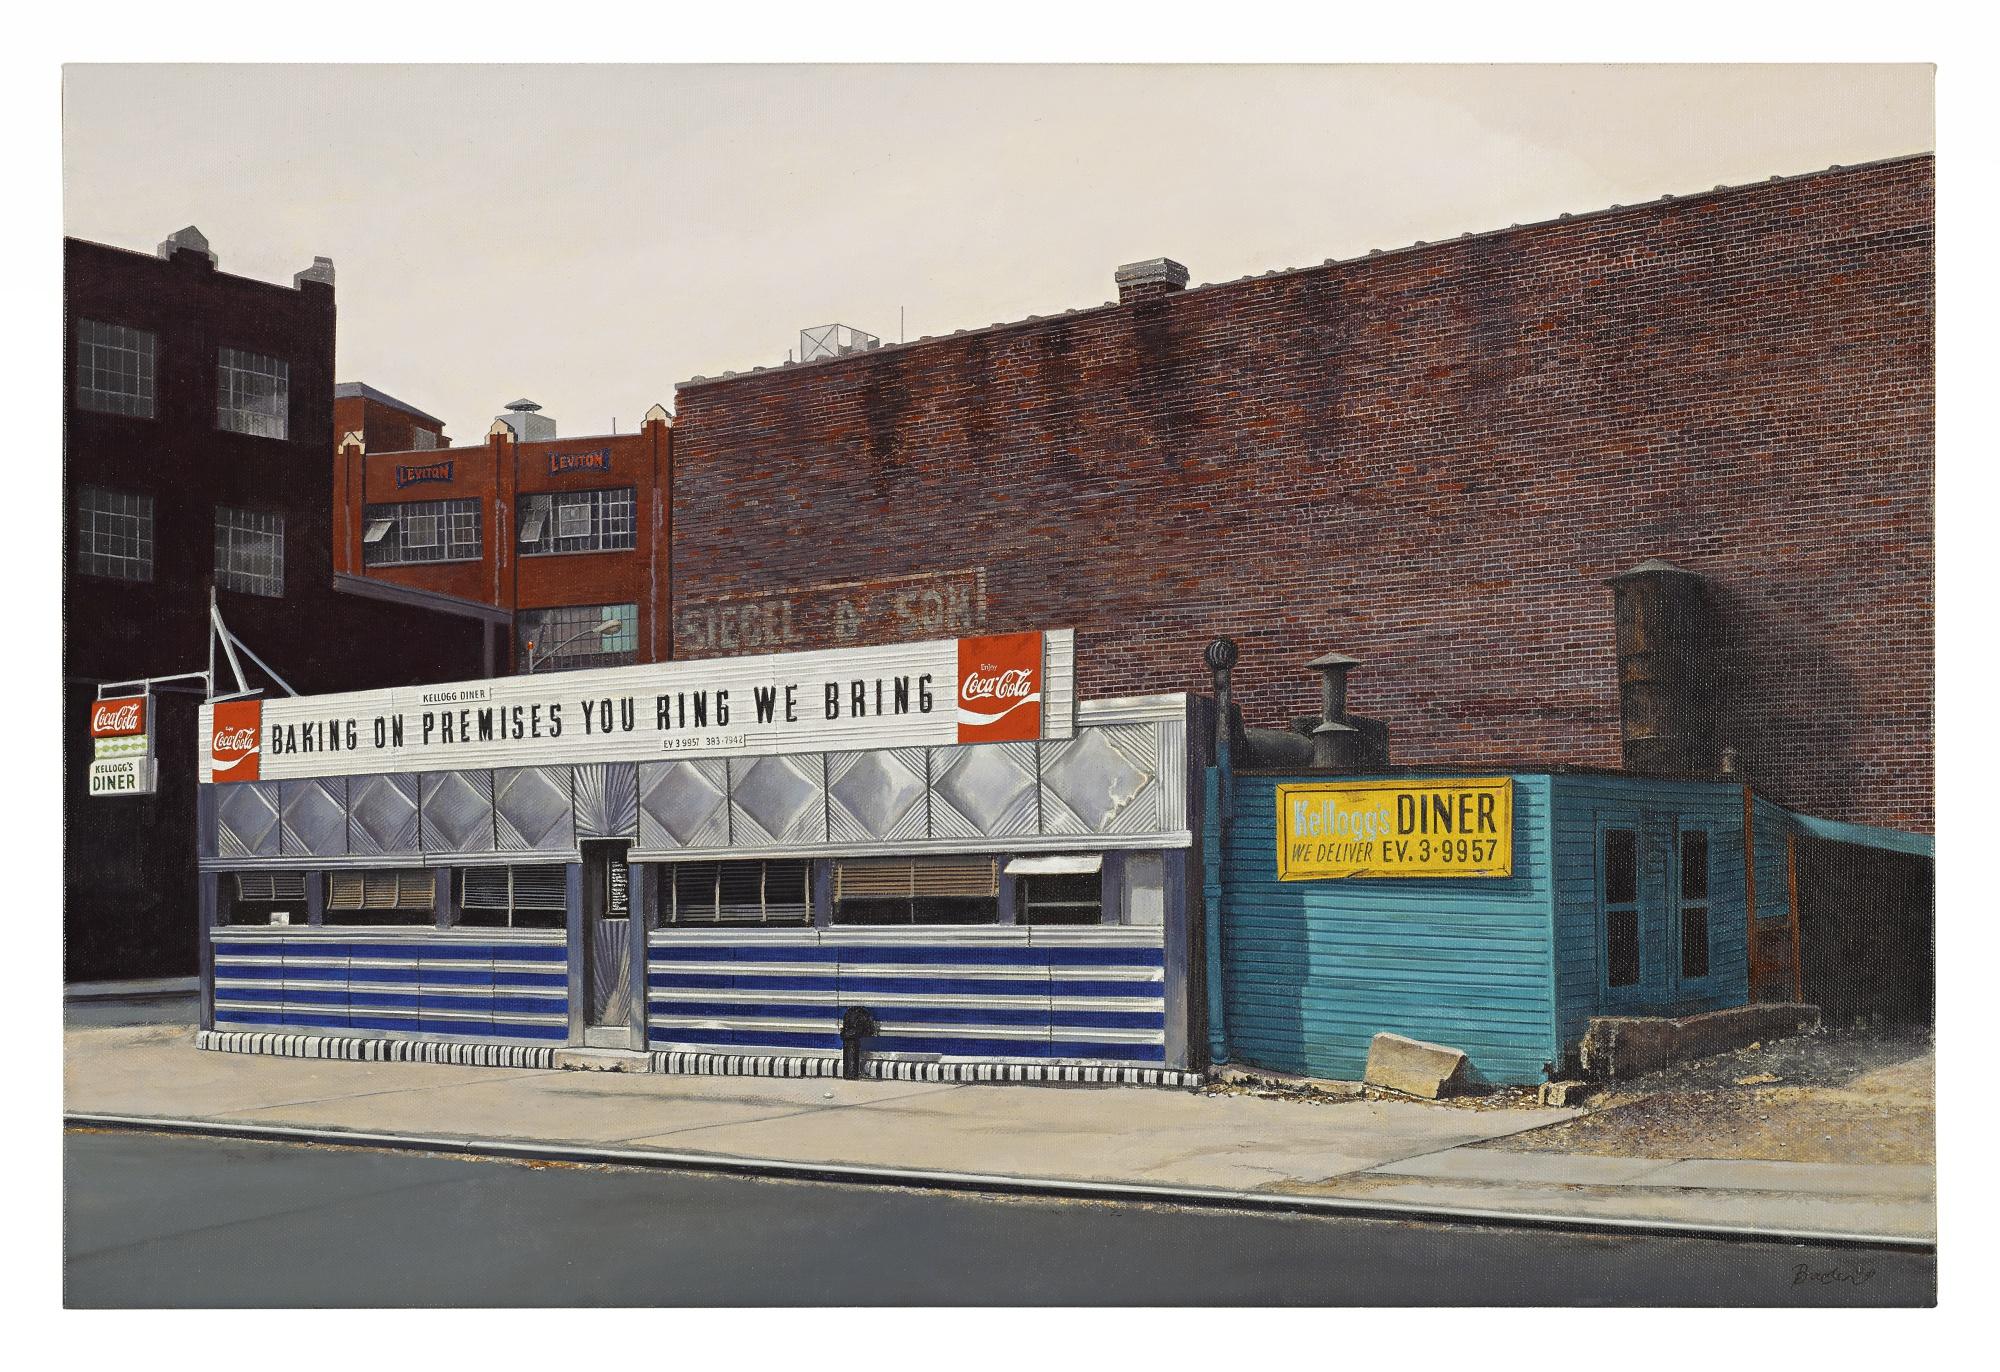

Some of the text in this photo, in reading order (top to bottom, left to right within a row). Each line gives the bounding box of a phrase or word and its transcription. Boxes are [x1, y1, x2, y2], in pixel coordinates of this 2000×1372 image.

[423, 689, 485, 703] KELLOGG DINER
[961, 668, 1032, 701] Coca-Cola
[93, 703, 140, 732] Coca-Cola
[271, 673, 932, 755] BAKING ON PREMISES YOU RING WE BRING
[213, 727, 256, 752] Coca-Cola
[95, 761, 133, 774] KELLOGG'S
[93, 773, 136, 791] DINER
[1293, 792, 1498, 842] Kellogg's DINER
[1292, 842, 1313, 863] WE
[1316, 841, 1373, 863] DELIVER
[1382, 839, 1414, 863] EV.
